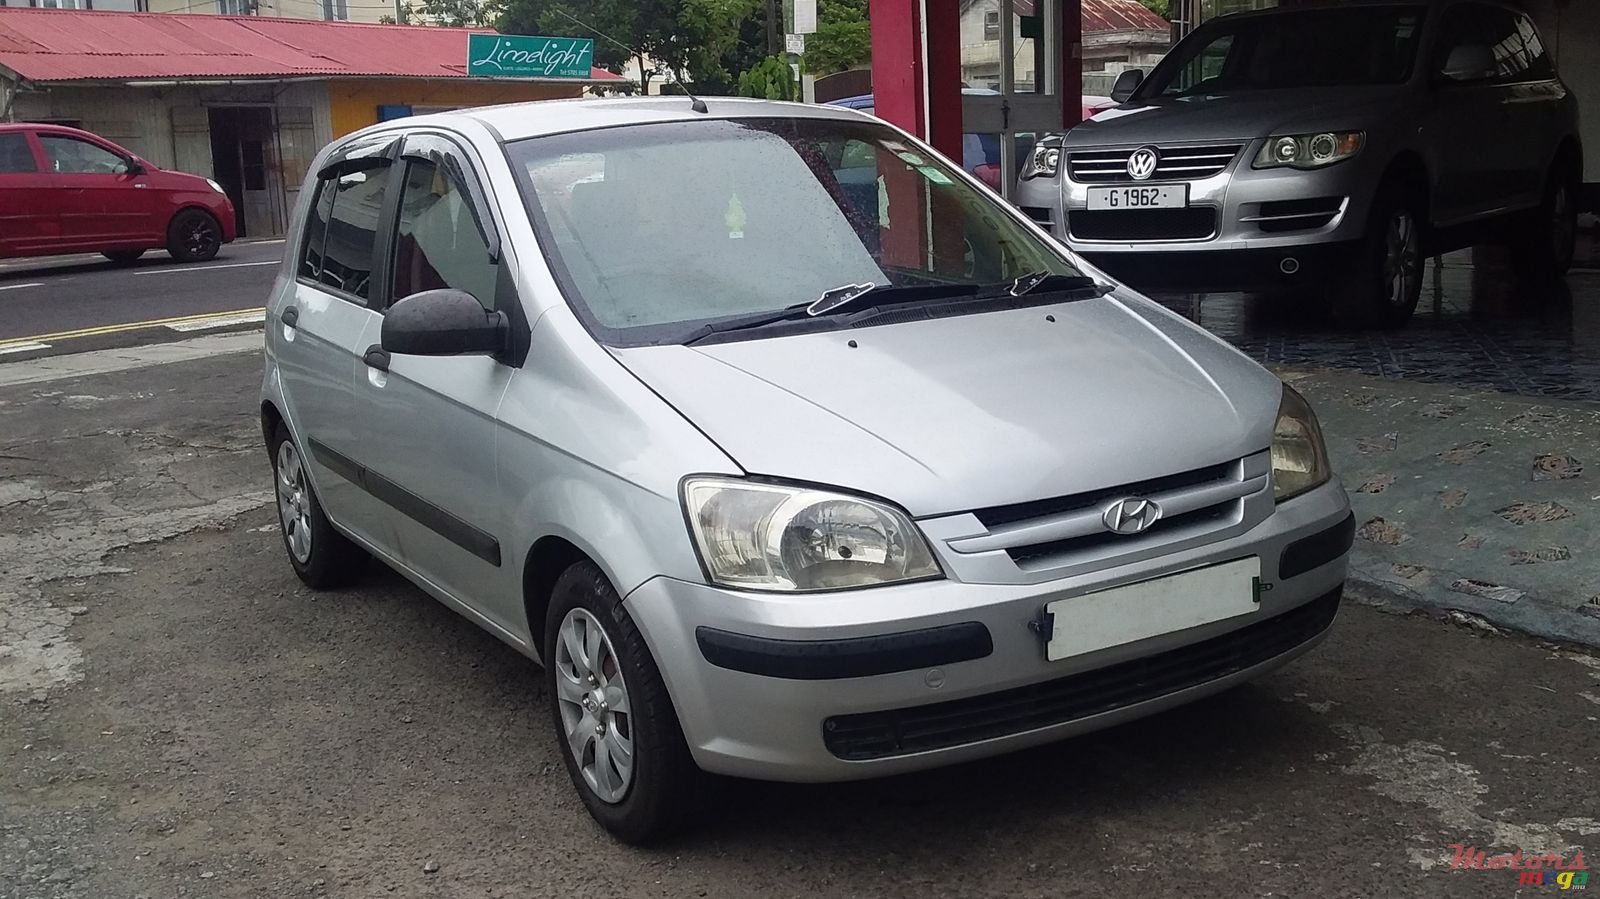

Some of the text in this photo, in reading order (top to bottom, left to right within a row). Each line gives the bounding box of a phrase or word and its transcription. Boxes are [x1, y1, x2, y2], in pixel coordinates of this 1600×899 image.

[472, 38, 590, 75] Limelight
[1110, 188, 1159, 207] G 1962
